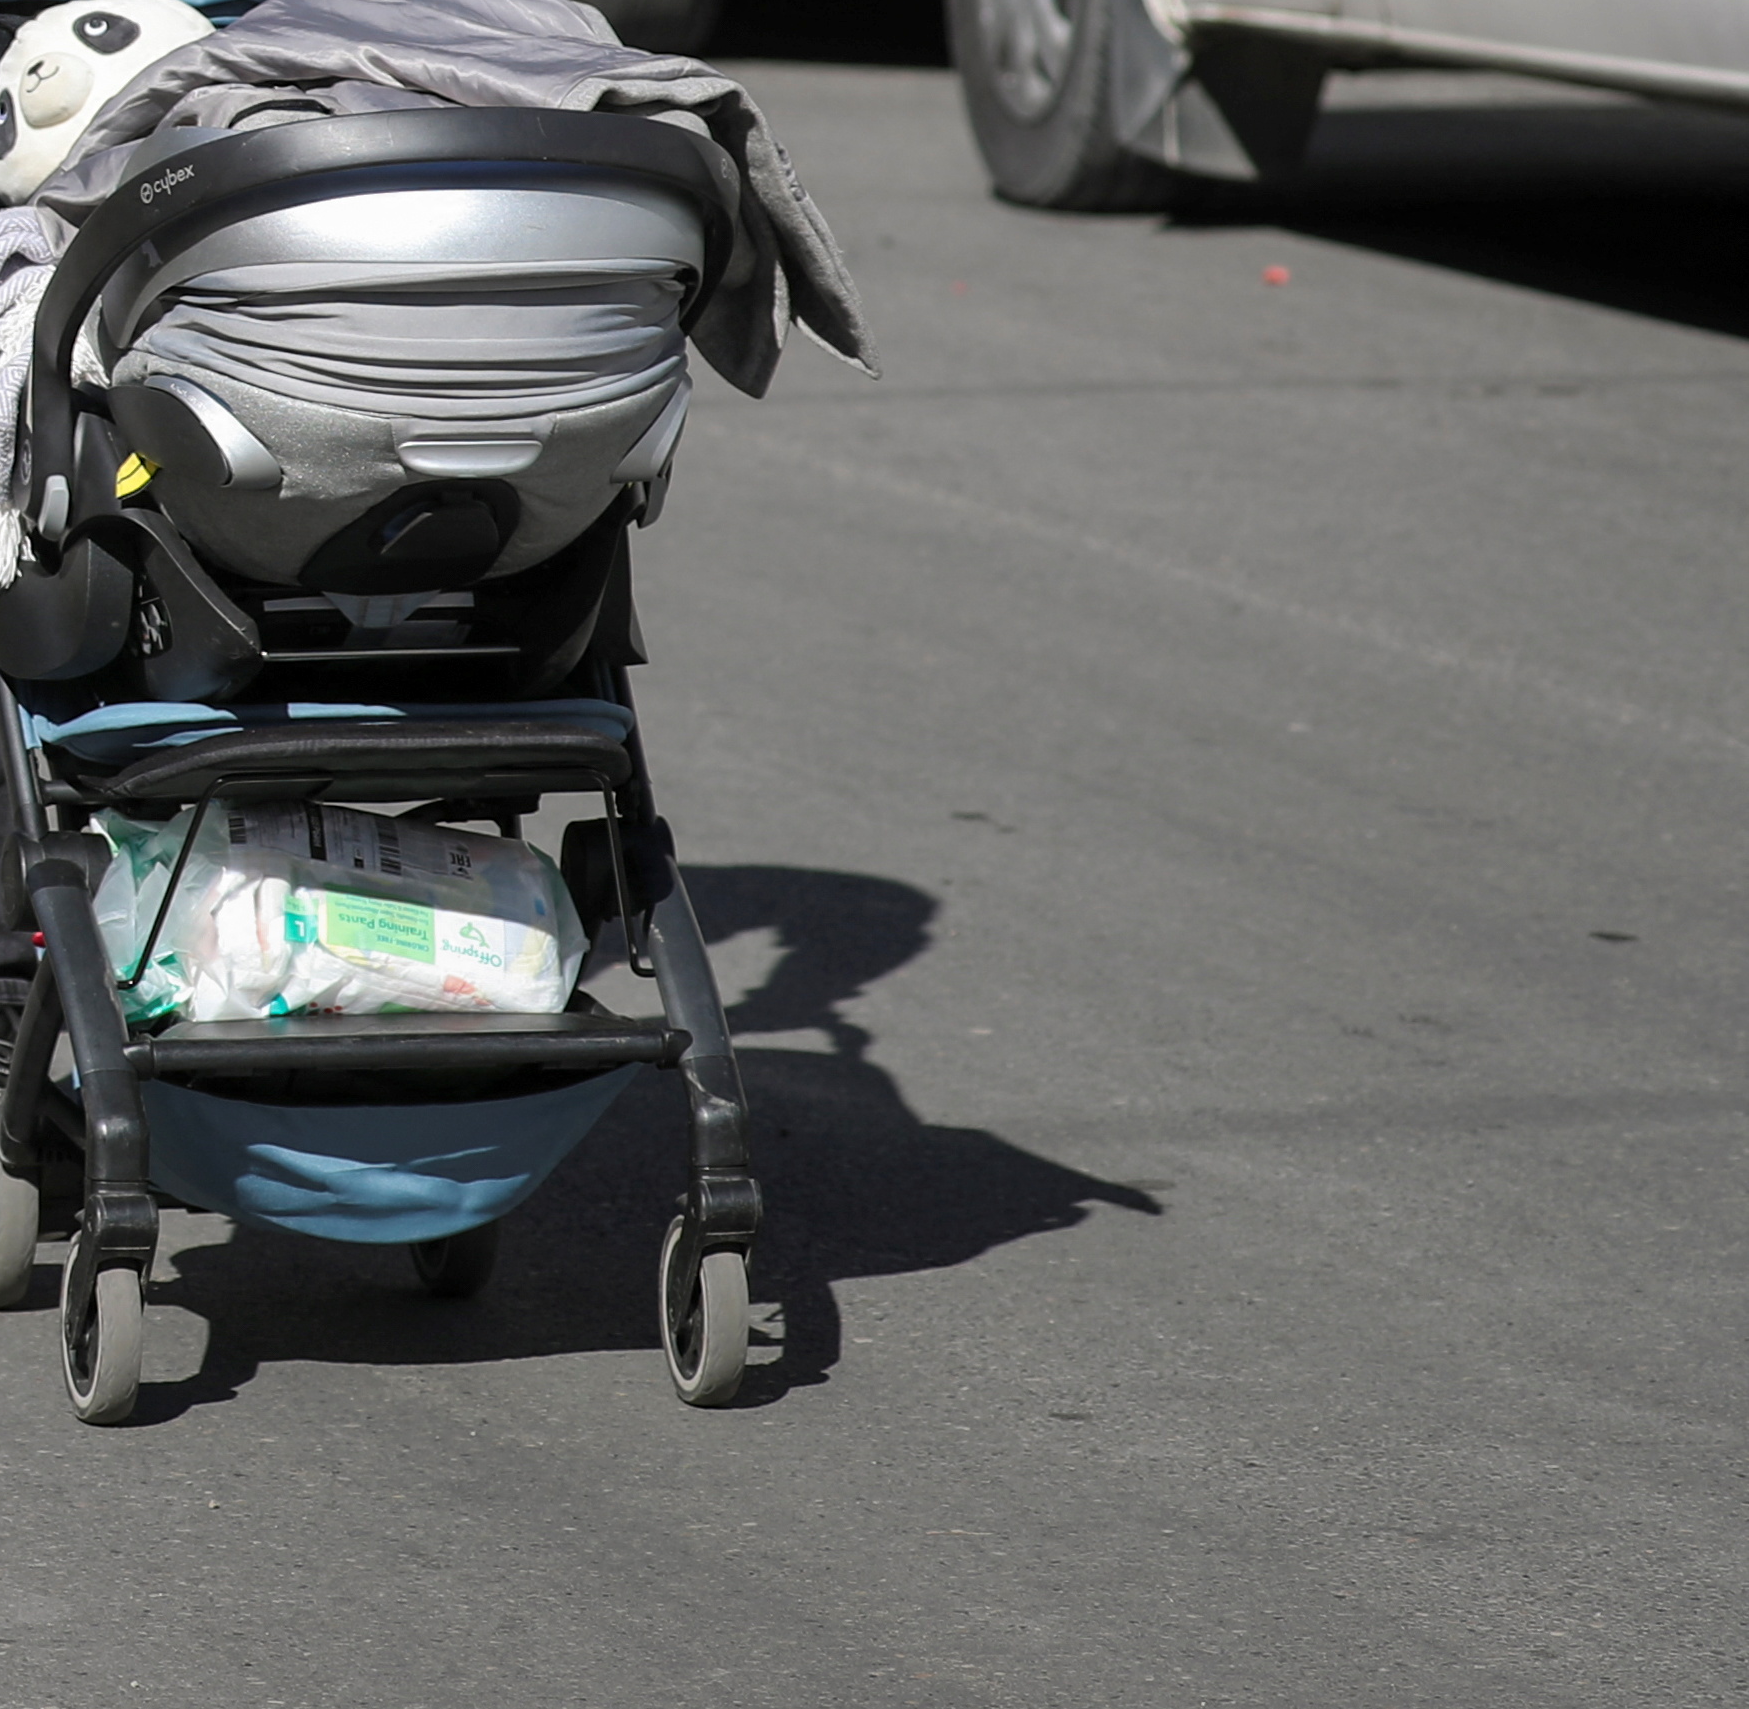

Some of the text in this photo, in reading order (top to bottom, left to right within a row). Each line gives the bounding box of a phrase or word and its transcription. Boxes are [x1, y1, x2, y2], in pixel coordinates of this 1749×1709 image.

[153, 164, 195, 196] cybex
[338, 913, 376, 929] Pants
[378, 919, 429, 941] Training
[442, 939, 503, 968] Offspring
